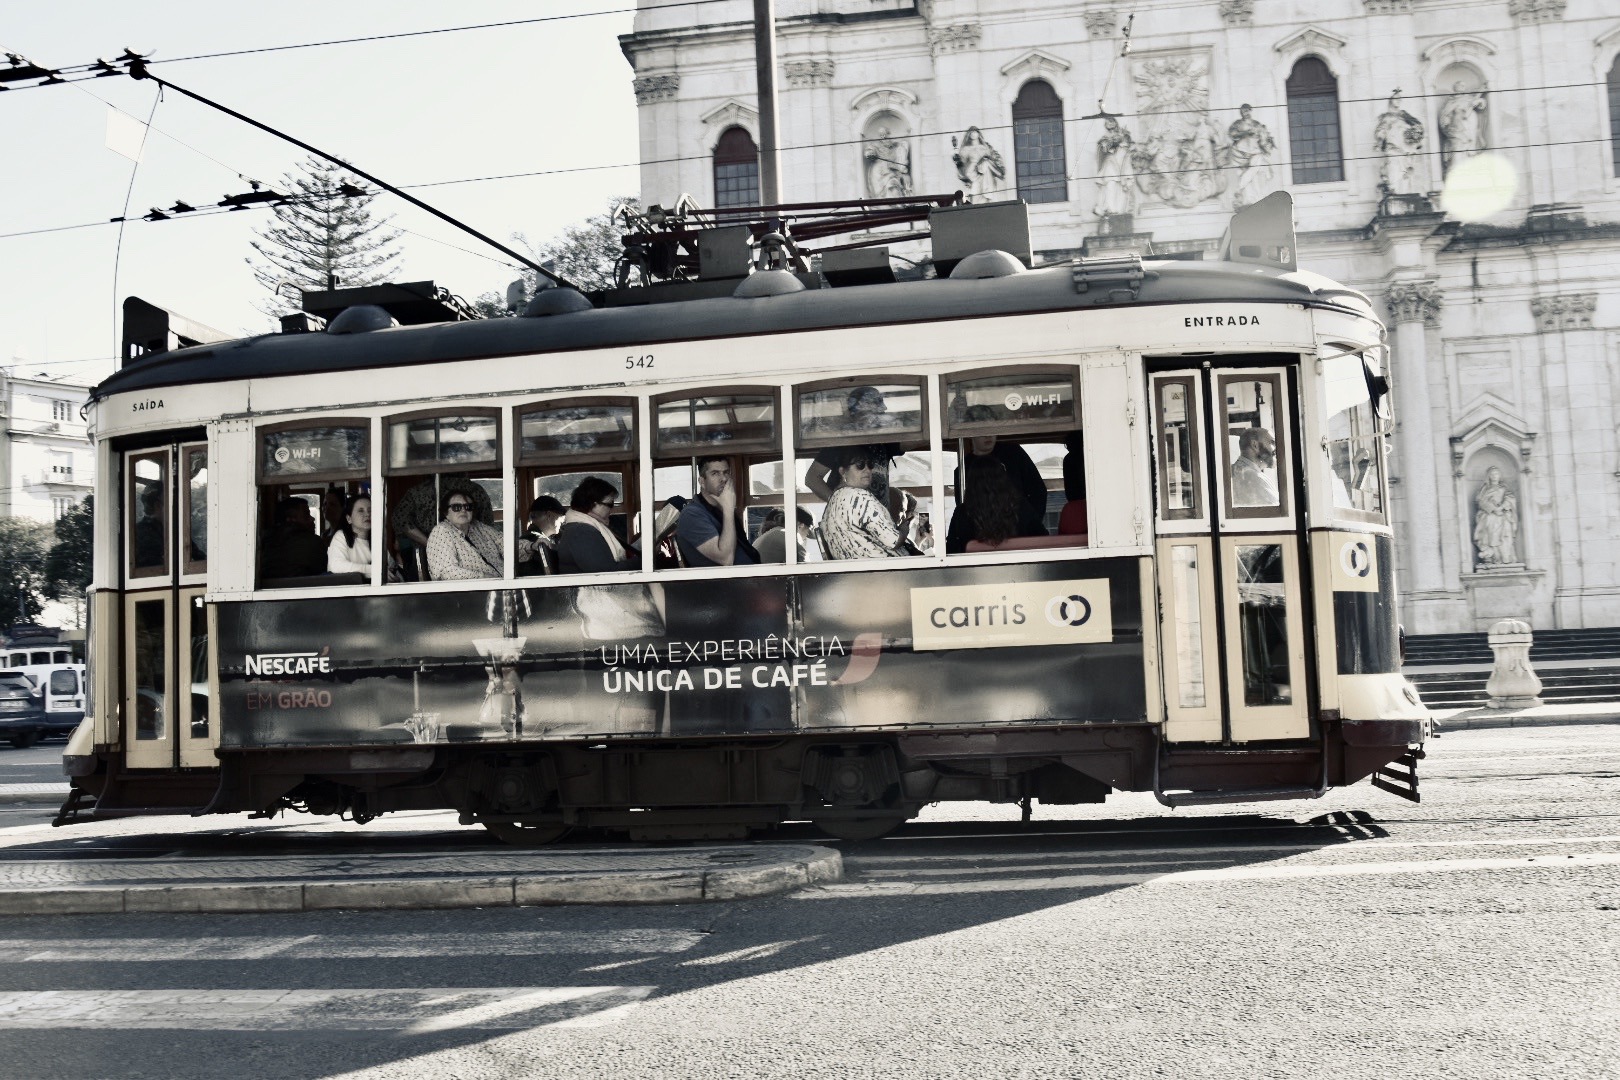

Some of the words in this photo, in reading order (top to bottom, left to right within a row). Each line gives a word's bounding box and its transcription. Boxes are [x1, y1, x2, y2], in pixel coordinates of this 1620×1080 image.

[1184, 315, 1261, 327] ENTRADA
[626, 355, 655, 370] 542
[132, 398, 165, 412] SAÍDA
[1025, 394, 1061, 406] WI-FI
[293, 447, 321, 459] WI-FI
[930, 596, 1027, 628] carris
[602, 643, 660, 665] UMA
[668, 633, 845, 663] EXPERIÊNCIA
[245, 645, 330, 676] NESCAFÉ
[603, 667, 694, 693] ÚNICA
[704, 667, 742, 690] DE
[752, 659, 828, 687] CAFÉ
[247, 692, 272, 710] EM
[278, 688, 332, 709] GRÃO
